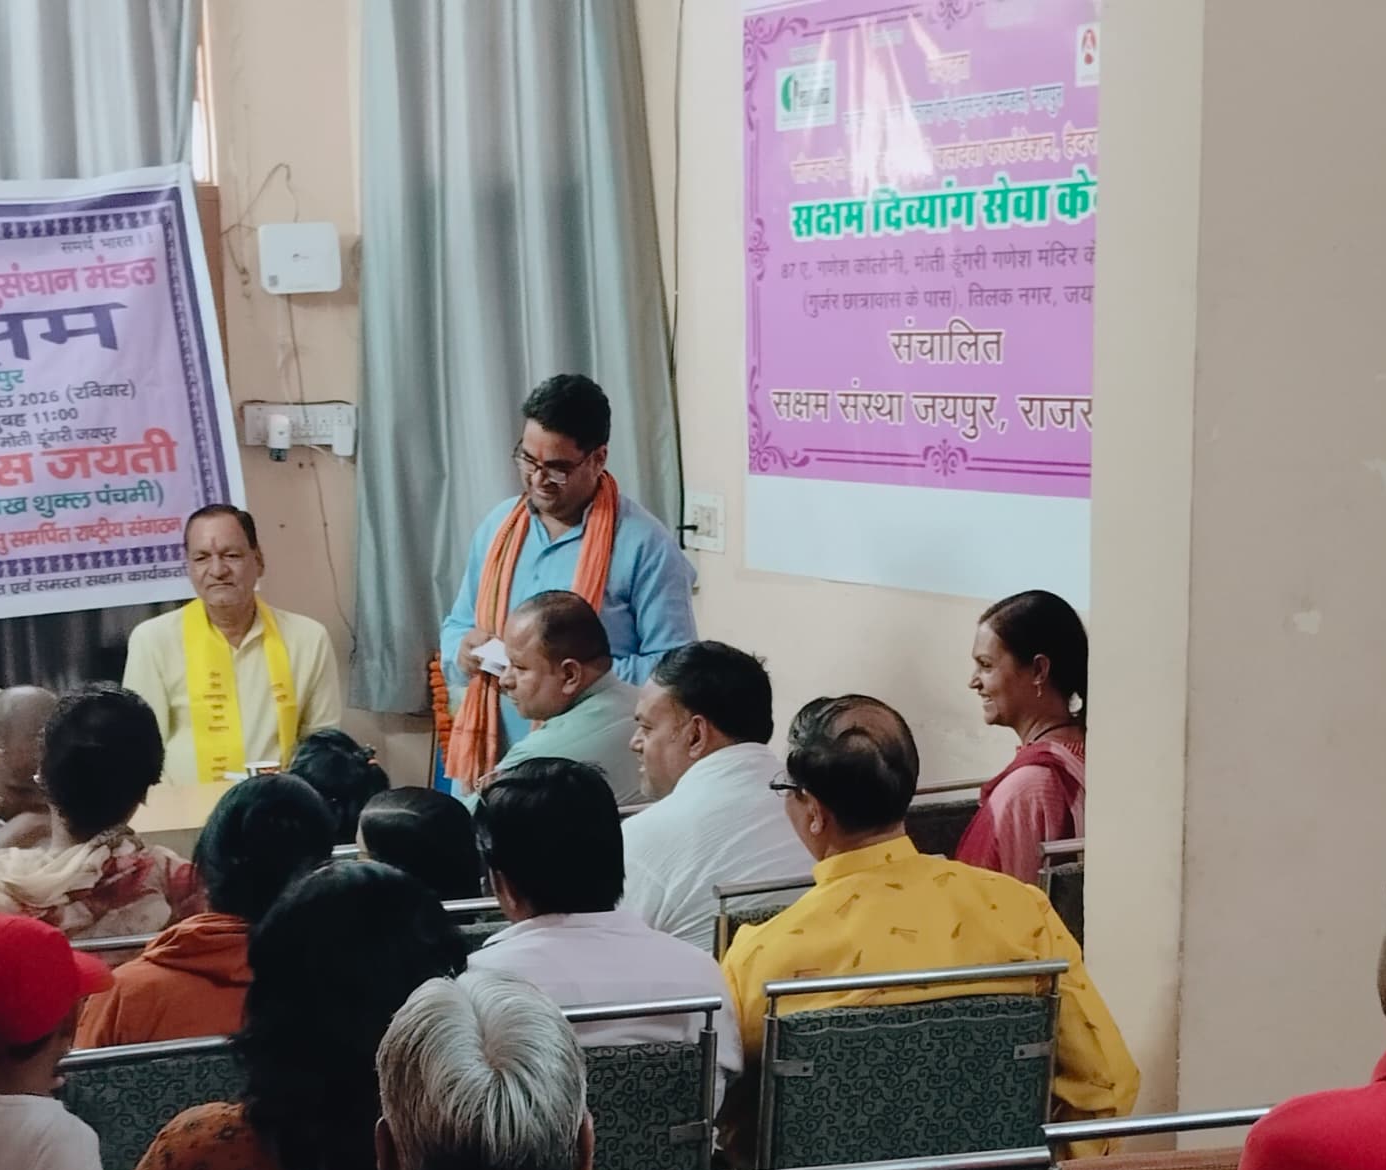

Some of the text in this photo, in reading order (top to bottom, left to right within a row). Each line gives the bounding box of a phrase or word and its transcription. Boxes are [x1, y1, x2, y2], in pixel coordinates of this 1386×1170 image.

[792, 169, 1097, 237] सक्षम दिव्यांग सेवा के
[82, 255, 156, 288] मंडल
[816, 253, 850, 276] गणेश
[992, 243, 1032, 269] गणेश
[1037, 240, 1078, 266] मंदिर
[968, 282, 1013, 308] तिलक
[1064, 285, 1094, 304] जय
[890, 318, 1003, 362] संचालित
[19, 390, 60, 407] 2026
[65, 378, 136, 404] (रविवार)
[32, 407, 79, 424] 11:00
[772, 391, 830, 421] सक्षम
[836, 379, 904, 423] संस्था
[913, 394, 1007, 440] जयपुर,
[76, 426, 118, 445] जयपुर
[33, 492, 92, 518] शुक्ल
[94, 479, 165, 507] पंचमी)
[10, 520, 72, 549] समर्पित
[75, 517, 125, 544] राष्ट्रीय
[128, 515, 182, 537] संगठन
[10, 579, 31, 595] एवं
[35, 576, 81, 592] समस्त
[84, 573, 124, 588] सक्षम
